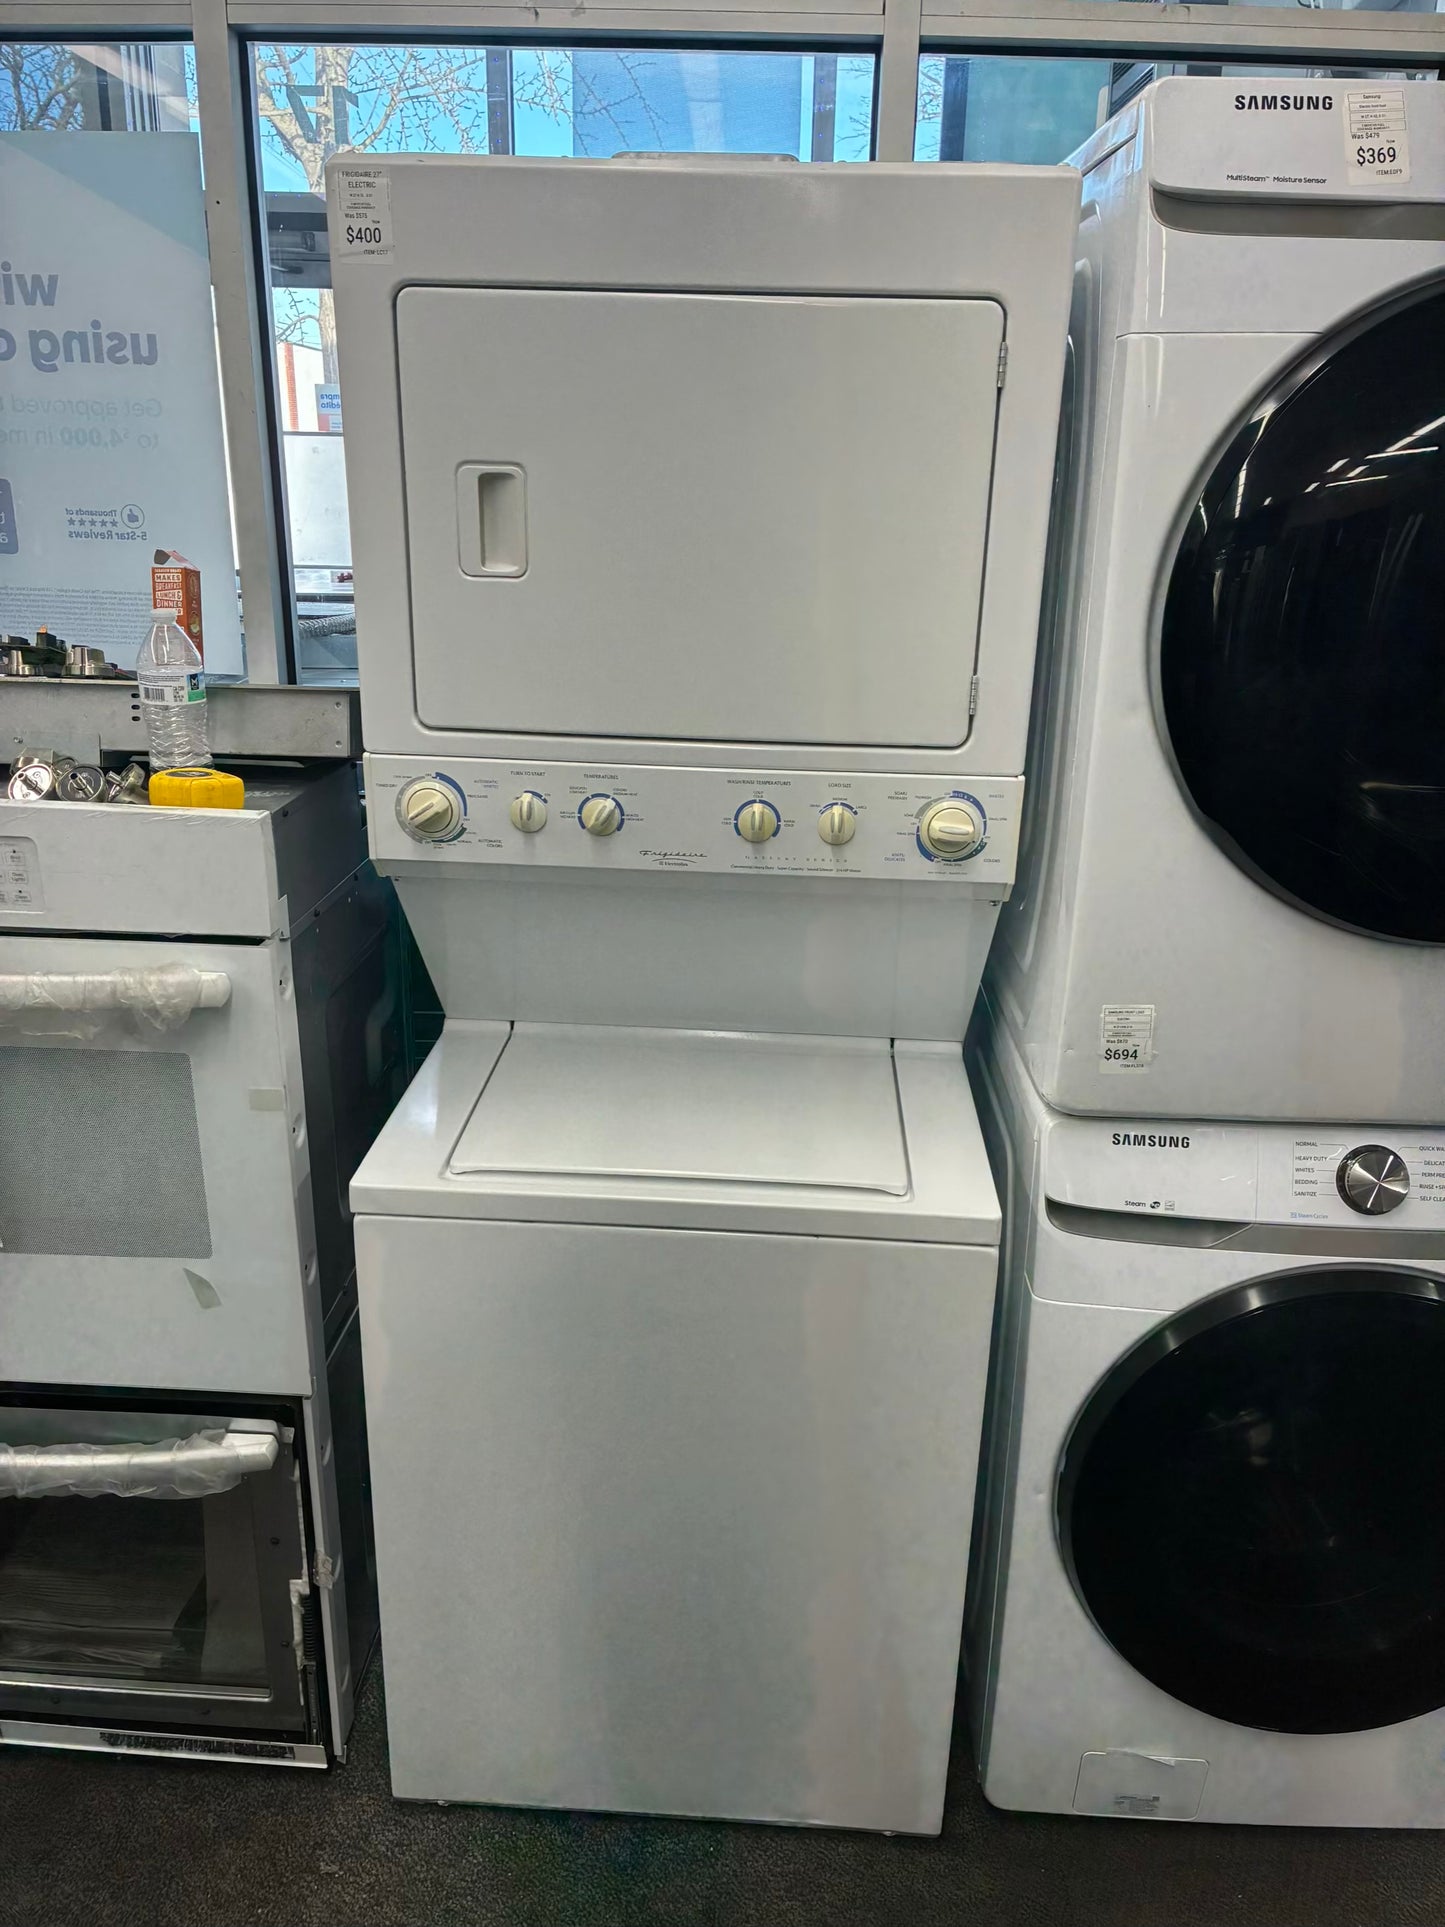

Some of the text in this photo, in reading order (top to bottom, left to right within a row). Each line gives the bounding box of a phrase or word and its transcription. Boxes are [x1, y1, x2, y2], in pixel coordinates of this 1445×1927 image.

[1234, 94, 1333, 110] SAMSUNG
[1365, 132, 1380, 140] $479
[1356, 145, 1397, 167] $369
[341, 170, 372, 178] FRIGIDAIRE
[347, 181, 377, 189] ELECTRIC
[346, 224, 382, 245] $400
[156, 599, 182, 608] DINNER
[639, 850, 708, 858] Frigidaire
[1104, 1047, 1139, 1062] $694
[1111, 1132, 1190, 1149] SAMSUNG
[1124, 1200, 1147, 1208] Steam
